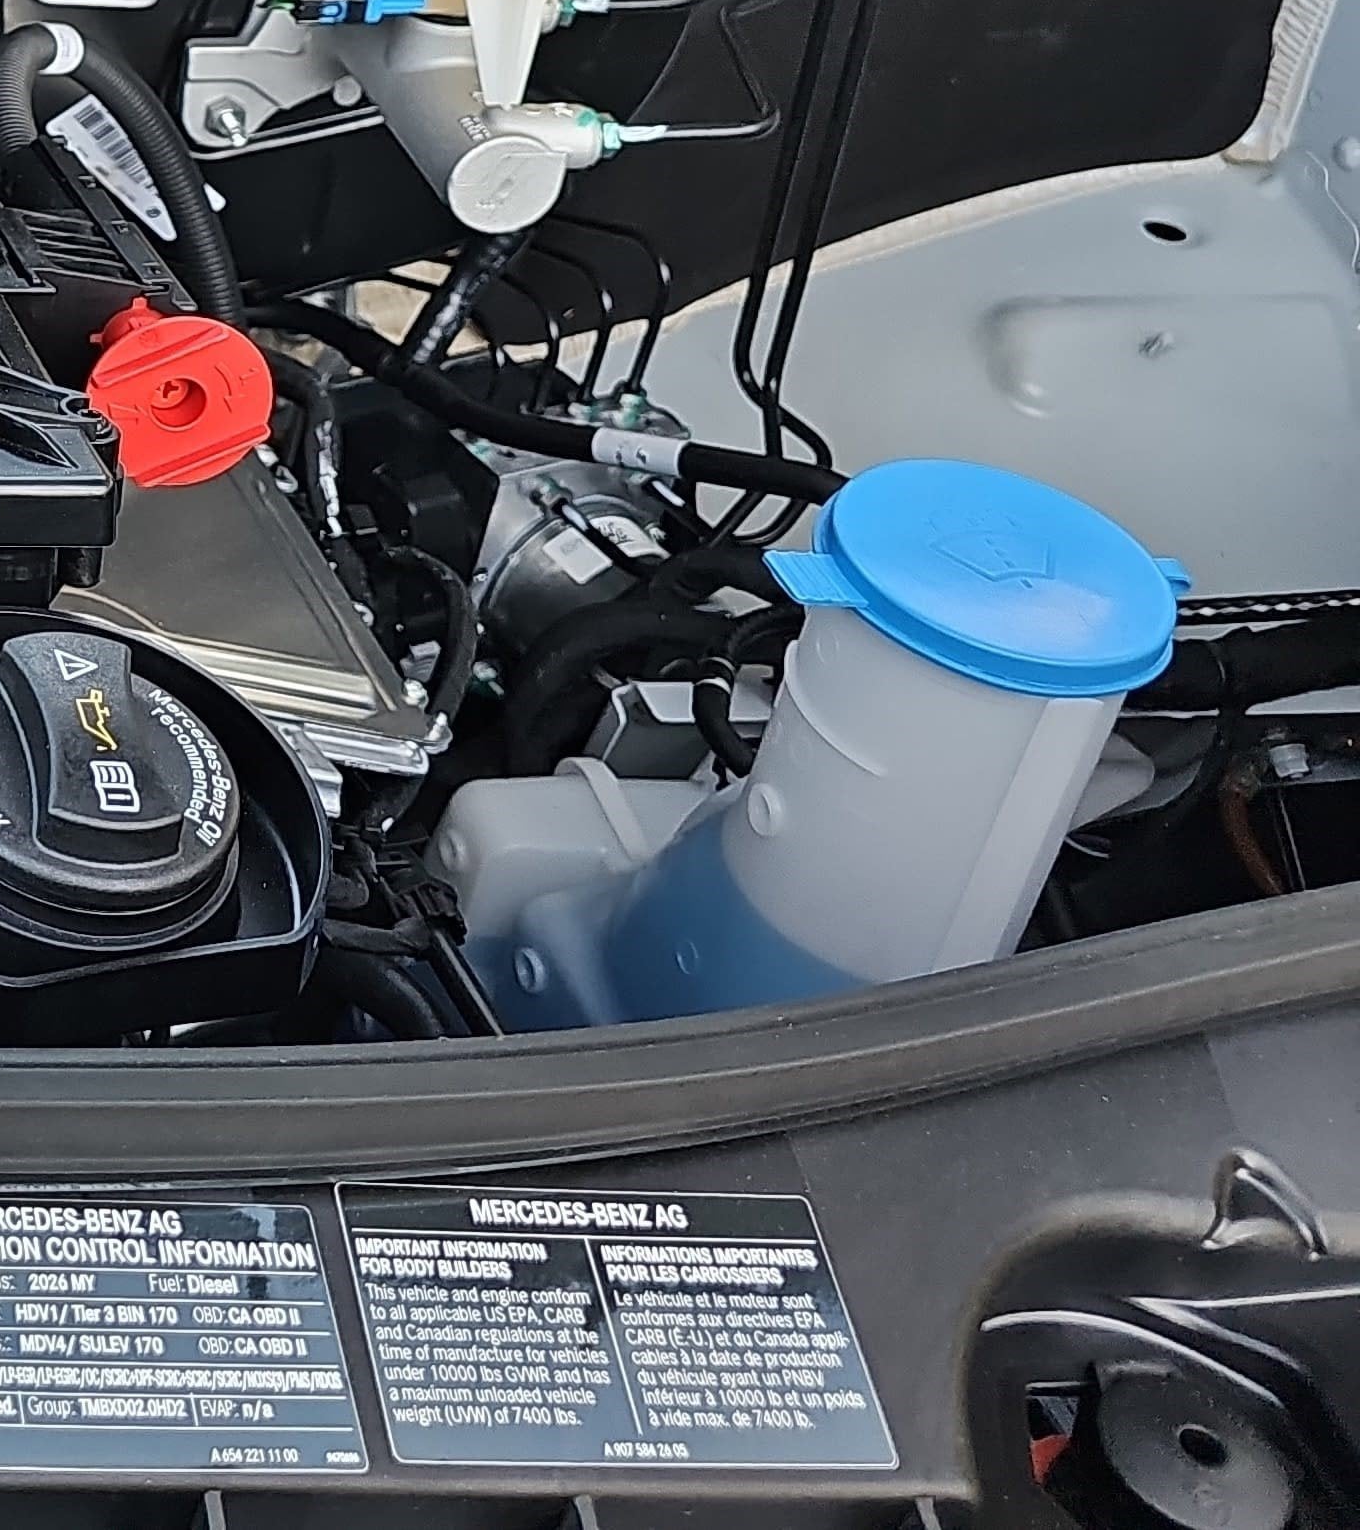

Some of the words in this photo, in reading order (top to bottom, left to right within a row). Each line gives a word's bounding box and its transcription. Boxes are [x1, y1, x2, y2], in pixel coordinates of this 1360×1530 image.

[148, 688, 232, 822] Mercedes-Benz
[150, 706, 212, 824] recommended
[149, 1210, 183, 1235] AG
[469, 1199, 653, 1228] MERCEDES-BENZ
[656, 1204, 689, 1228] AG
[46, 1237, 156, 1264] CONTROL
[158, 1240, 315, 1269] INFORMATION
[356, 1238, 441, 1257] IMPORTANT
[443, 1241, 547, 1261] INFORMATION
[600, 1244, 713, 1265] INFORMATIONS
[713, 1247, 818, 1269] IMPORTANTES
[360, 1258, 392, 1275] FOR
[394, 1258, 435, 1277] BODY
[437, 1260, 512, 1280] BUILDERS
[607, 1265, 650, 1283] POUR
[652, 1265, 679, 1282] LES
[680, 1266, 784, 1286] CARROSSIERS
[28, 1274, 68, 1292] 2026
[70, 1274, 95, 1292] MY
[148, 1274, 185, 1294] Fuel:
[187, 1275, 240, 1294] Diesel
[365, 1283, 395, 1300] This
[398, 1284, 449, 1302] vehicle
[452, 1286, 479, 1303] and
[481, 1288, 529, 1307] engine
[532, 1288, 591, 1305] conform
[614, 1291, 632, 1307] Le
[635, 1290, 692, 1308] véhicule
[695, 1294, 711, 1308] et
[713, 1293, 727, 1308] le
[729, 1294, 779, 1309] moteur
[782, 1293, 816, 1310] sont
[15, 1303, 68, 1325] HDV1/
[71, 1304, 101, 1323] Tier
[103, 1305, 115, 1323] 3
[117, 1306, 144, 1324] BIN
[148, 1306, 177, 1325] 170
[192, 1306, 228, 1324] OBD:
[229, 1307, 253, 1325] CA
[254, 1307, 288, 1326] OBD
[289, 1308, 301, 1326] II
[370, 1304, 387, 1320] to
[390, 1304, 406, 1320] all
[410, 1304, 480, 1324] applicable
[483, 1307, 506, 1323] US
[508, 1307, 542, 1325] EPA,
[544, 1308, 585, 1325] CARB
[620, 1311, 694, 1327] conformes
[697, 1315, 721, 1327] aux
[723, 1311, 794, 1328] directives
[796, 1312, 826, 1329] EPA
[19, 1335, 77, 1356] MDV4/
[79, 1336, 129, 1354] SULEV
[134, 1337, 164, 1355] 170
[198, 1338, 233, 1355] OBD:
[234, 1338, 258, 1356] CA
[259, 1338, 293, 1357] OBD
[294, 1339, 308, 1357] II
[375, 1324, 403, 1340] and
[405, 1324, 472, 1342] Canadian
[475, 1326, 554, 1346] regulations
[557, 1328, 571, 1343] at
[573, 1328, 599, 1344] the
[379, 1344, 412, 1360] time
[415, 1344, 430, 1360] of
[433, 1345, 523, 1362] manufacture
[526, 1346, 545, 1363] for
[549, 1347, 609, 1364] vehicles
[384, 1364, 425, 1381] under
[430, 1365, 477, 1382] 10000
[480, 1366, 502, 1382] lbs
[504, 1367, 551, 1383] GVWR
[553, 1367, 580, 1384] and
[583, 1368, 611, 1384] has
[388, 1389, 399, 1401] a
[402, 1387, 473, 1402] maximum
[475, 1386, 541, 1403] unloaded
[544, 1388, 596, 1405] vehicle
[27, 1397, 76, 1418] Group:
[199, 1399, 240, 1418] EVAP:
[241, 1400, 274, 1421] n/a
[392, 1405, 443, 1425] weight
[445, 1407, 492, 1426] (UVW)
[494, 1407, 509, 1424] of
[511, 1408, 551, 1425] 7400
[554, 1408, 583, 1425] lbs.
[211, 1448, 221, 1462] A
[222, 1448, 242, 1463] 654
[244, 1448, 265, 1463] 221
[268, 1448, 281, 1463] 11
[283, 1449, 299, 1463] 00
[604, 1442, 612, 1457] A
[613, 1442, 633, 1458] 907
[673, 1444, 689, 1459] 05
